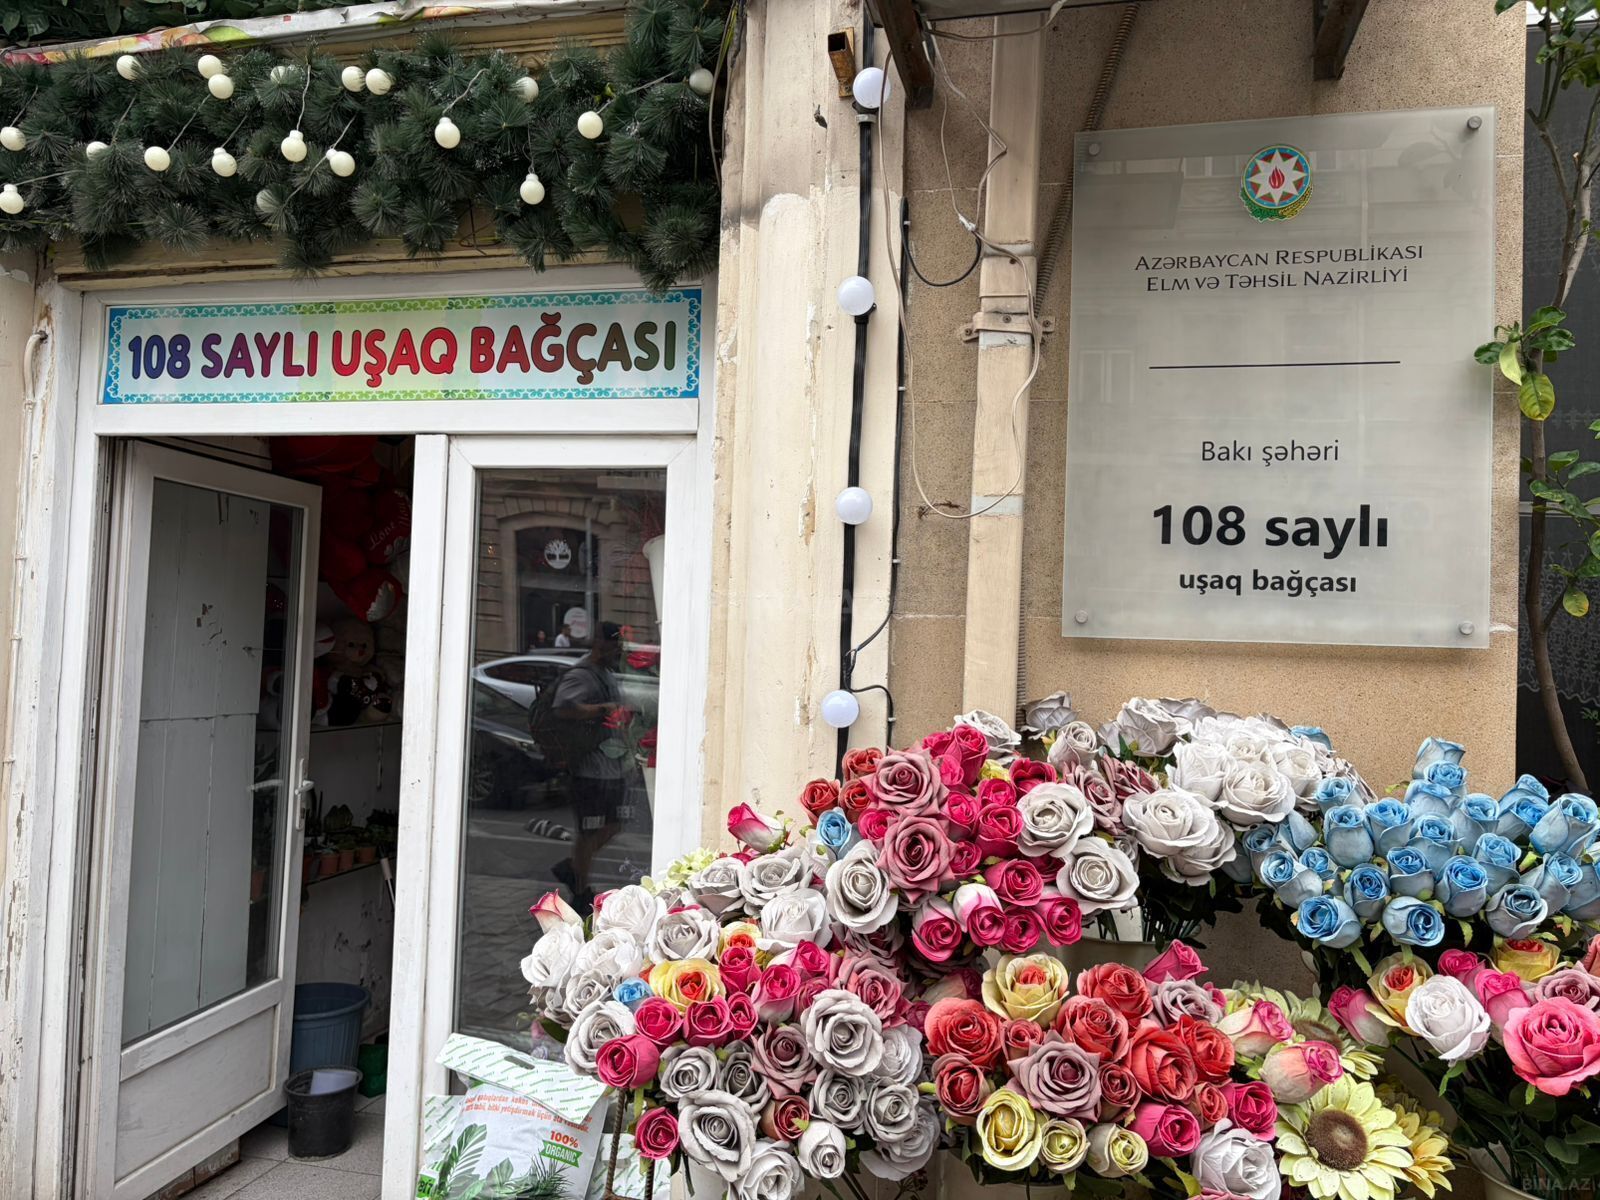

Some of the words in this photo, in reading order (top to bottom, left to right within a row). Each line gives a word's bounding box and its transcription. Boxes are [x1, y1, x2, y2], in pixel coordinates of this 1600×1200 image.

[1134, 252, 1269, 271] AZƏRBAYCAN
[1275, 244, 1424, 265] RESPUBLİKASI
[1147, 276, 1190, 292] ELM
[1224, 271, 1297, 289] TƏHSİL
[1303, 265, 1408, 286] NAZİRLİYİ
[127, 333, 191, 380] 108
[200, 330, 319, 379] SAYLI
[331, 326, 459, 388] UŞAQ
[469, 311, 677, 386] BAĞÇASI
[1200, 439, 1253, 462] Bakı
[1261, 439, 1340, 467] şəhəri
[1152, 504, 1246, 546] 108
[1264, 504, 1388, 560] saylı
[1179, 571, 1242, 596] uşaq
[1252, 568, 1356, 597] bağçası
[550, 1129, 579, 1148] 100%
[545, 1143, 577, 1163] ORGANIC
